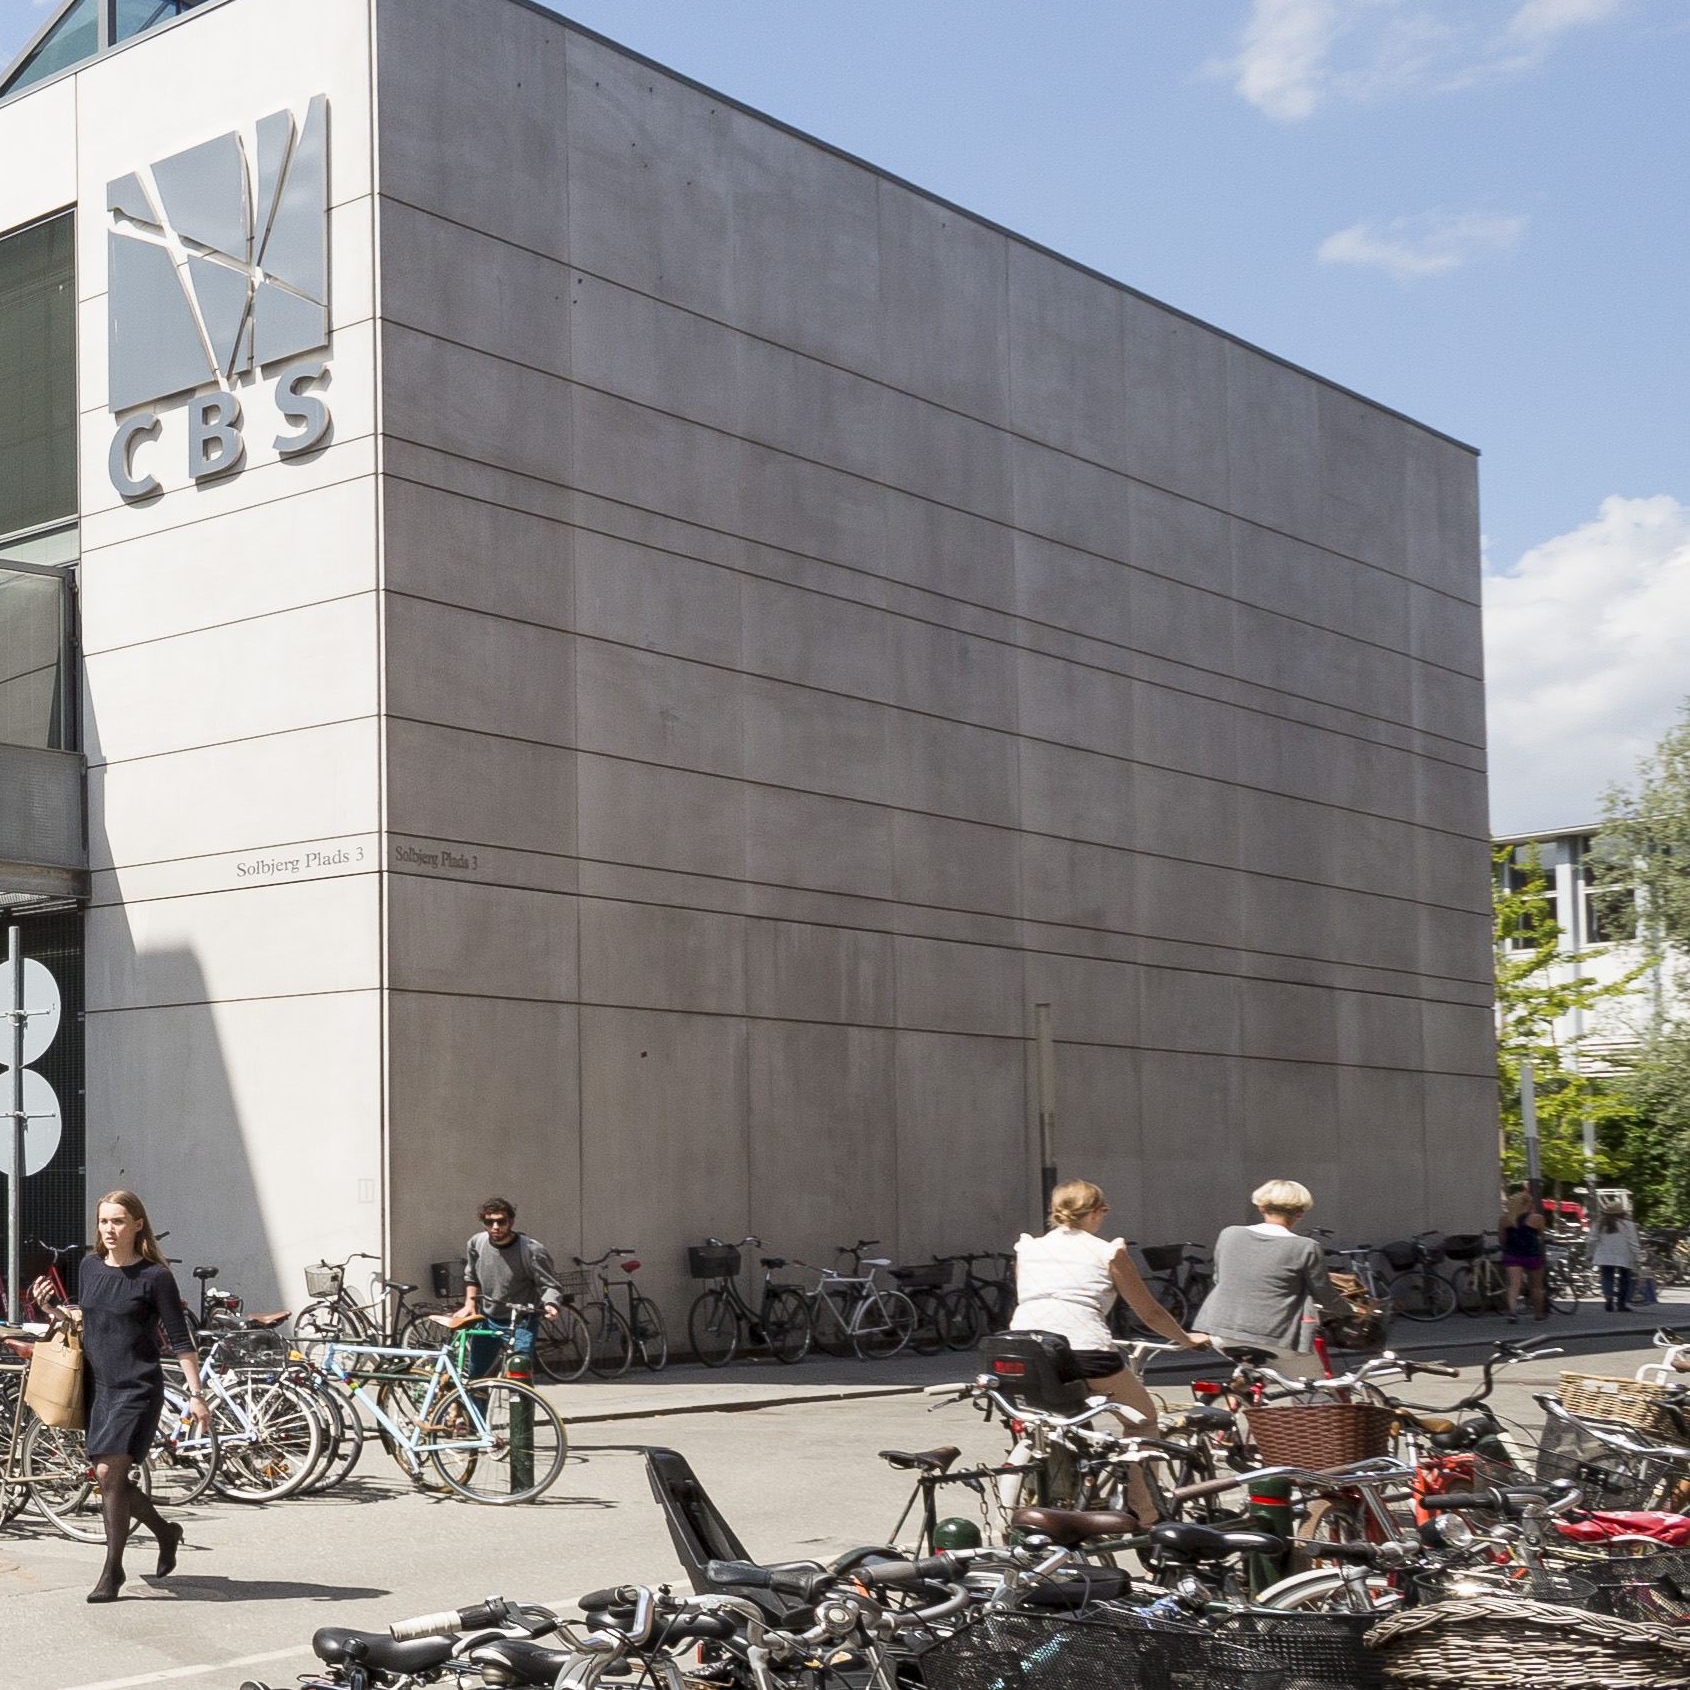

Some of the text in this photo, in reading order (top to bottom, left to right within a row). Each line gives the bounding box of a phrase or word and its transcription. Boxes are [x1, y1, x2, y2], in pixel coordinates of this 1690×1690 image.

[108, 361, 331, 497] CBS
[236, 846, 365, 878] Solbjerg Plads 3
[395, 845, 478, 870] Solbjerg Plads 3
